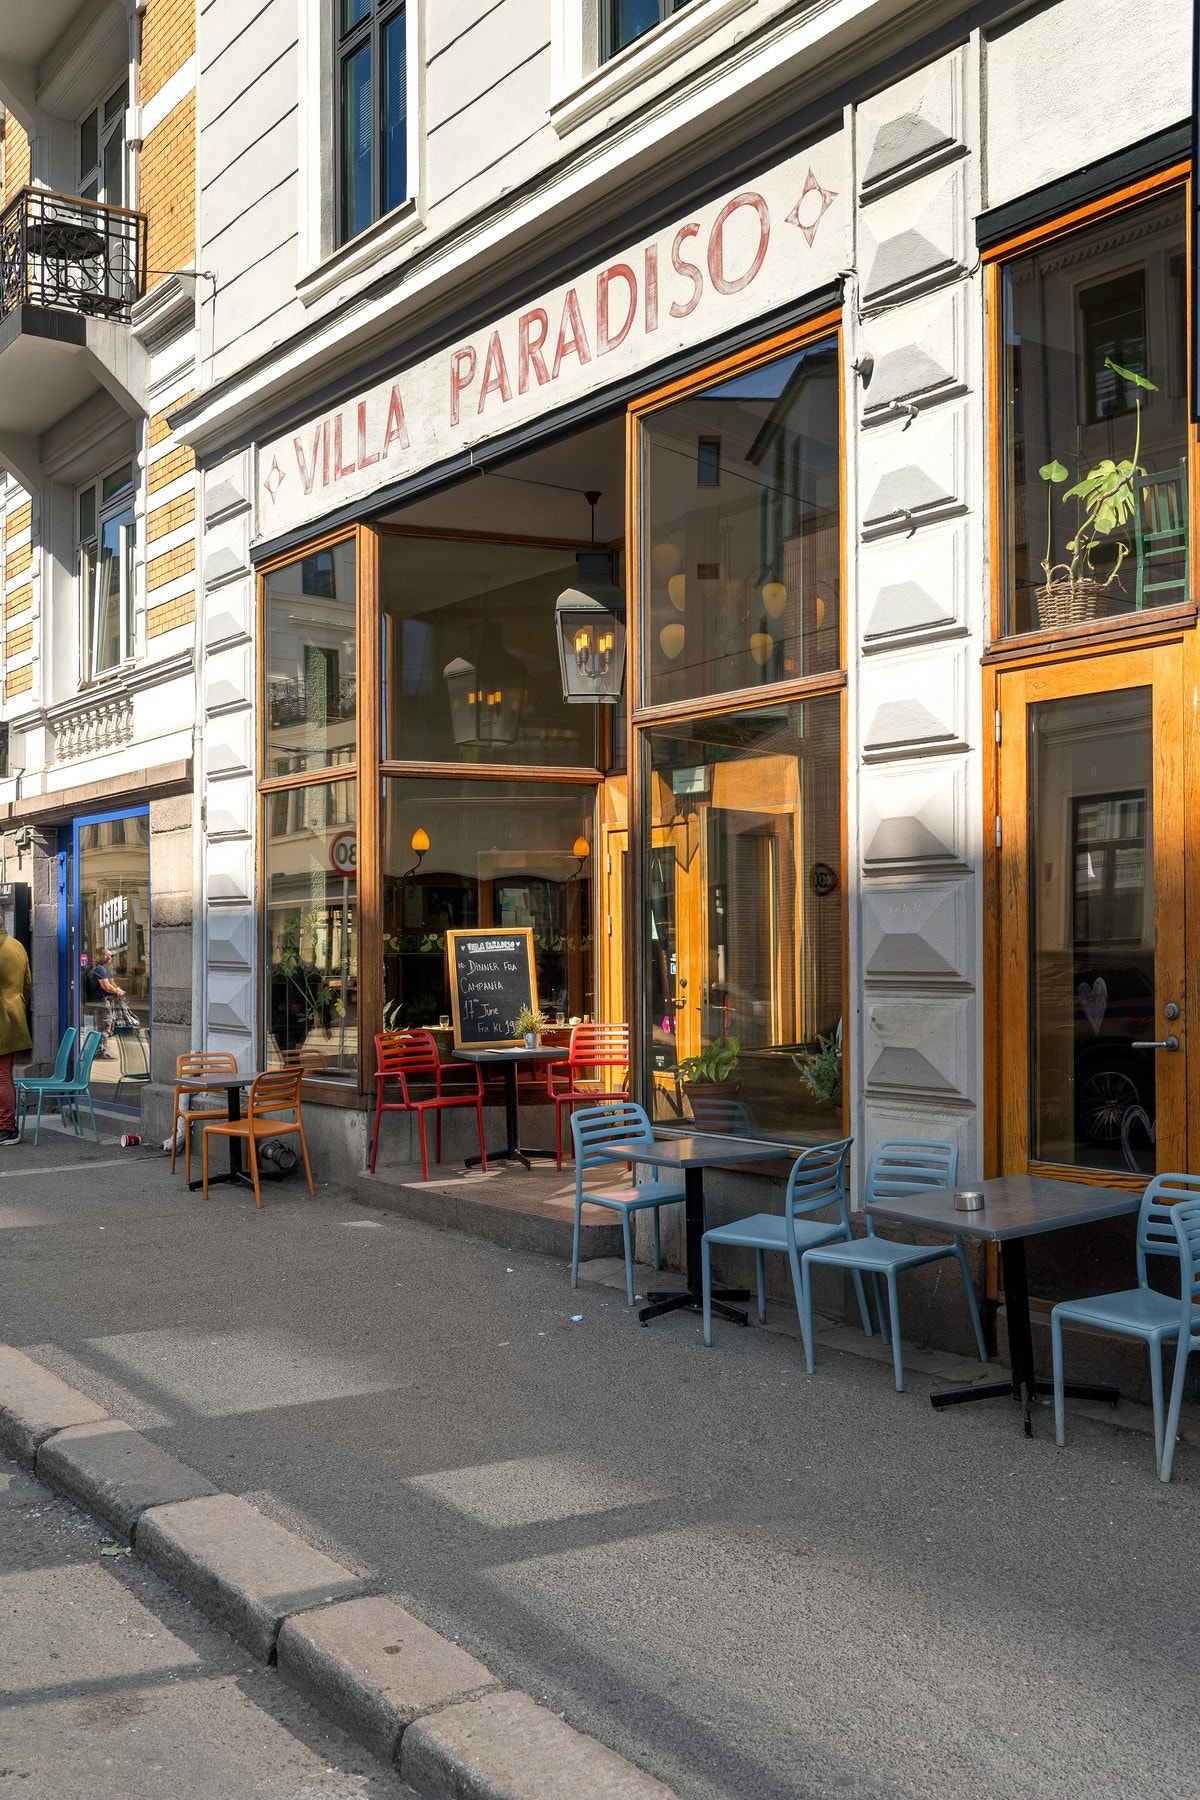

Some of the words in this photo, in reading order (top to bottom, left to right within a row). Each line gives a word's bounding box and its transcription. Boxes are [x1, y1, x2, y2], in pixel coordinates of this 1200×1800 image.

[293, 384, 411, 495] VILLA
[450, 192, 770, 427] PARADISO
[99, 895, 123, 928] LISTEN
[477, 1004, 499, 1019] June
